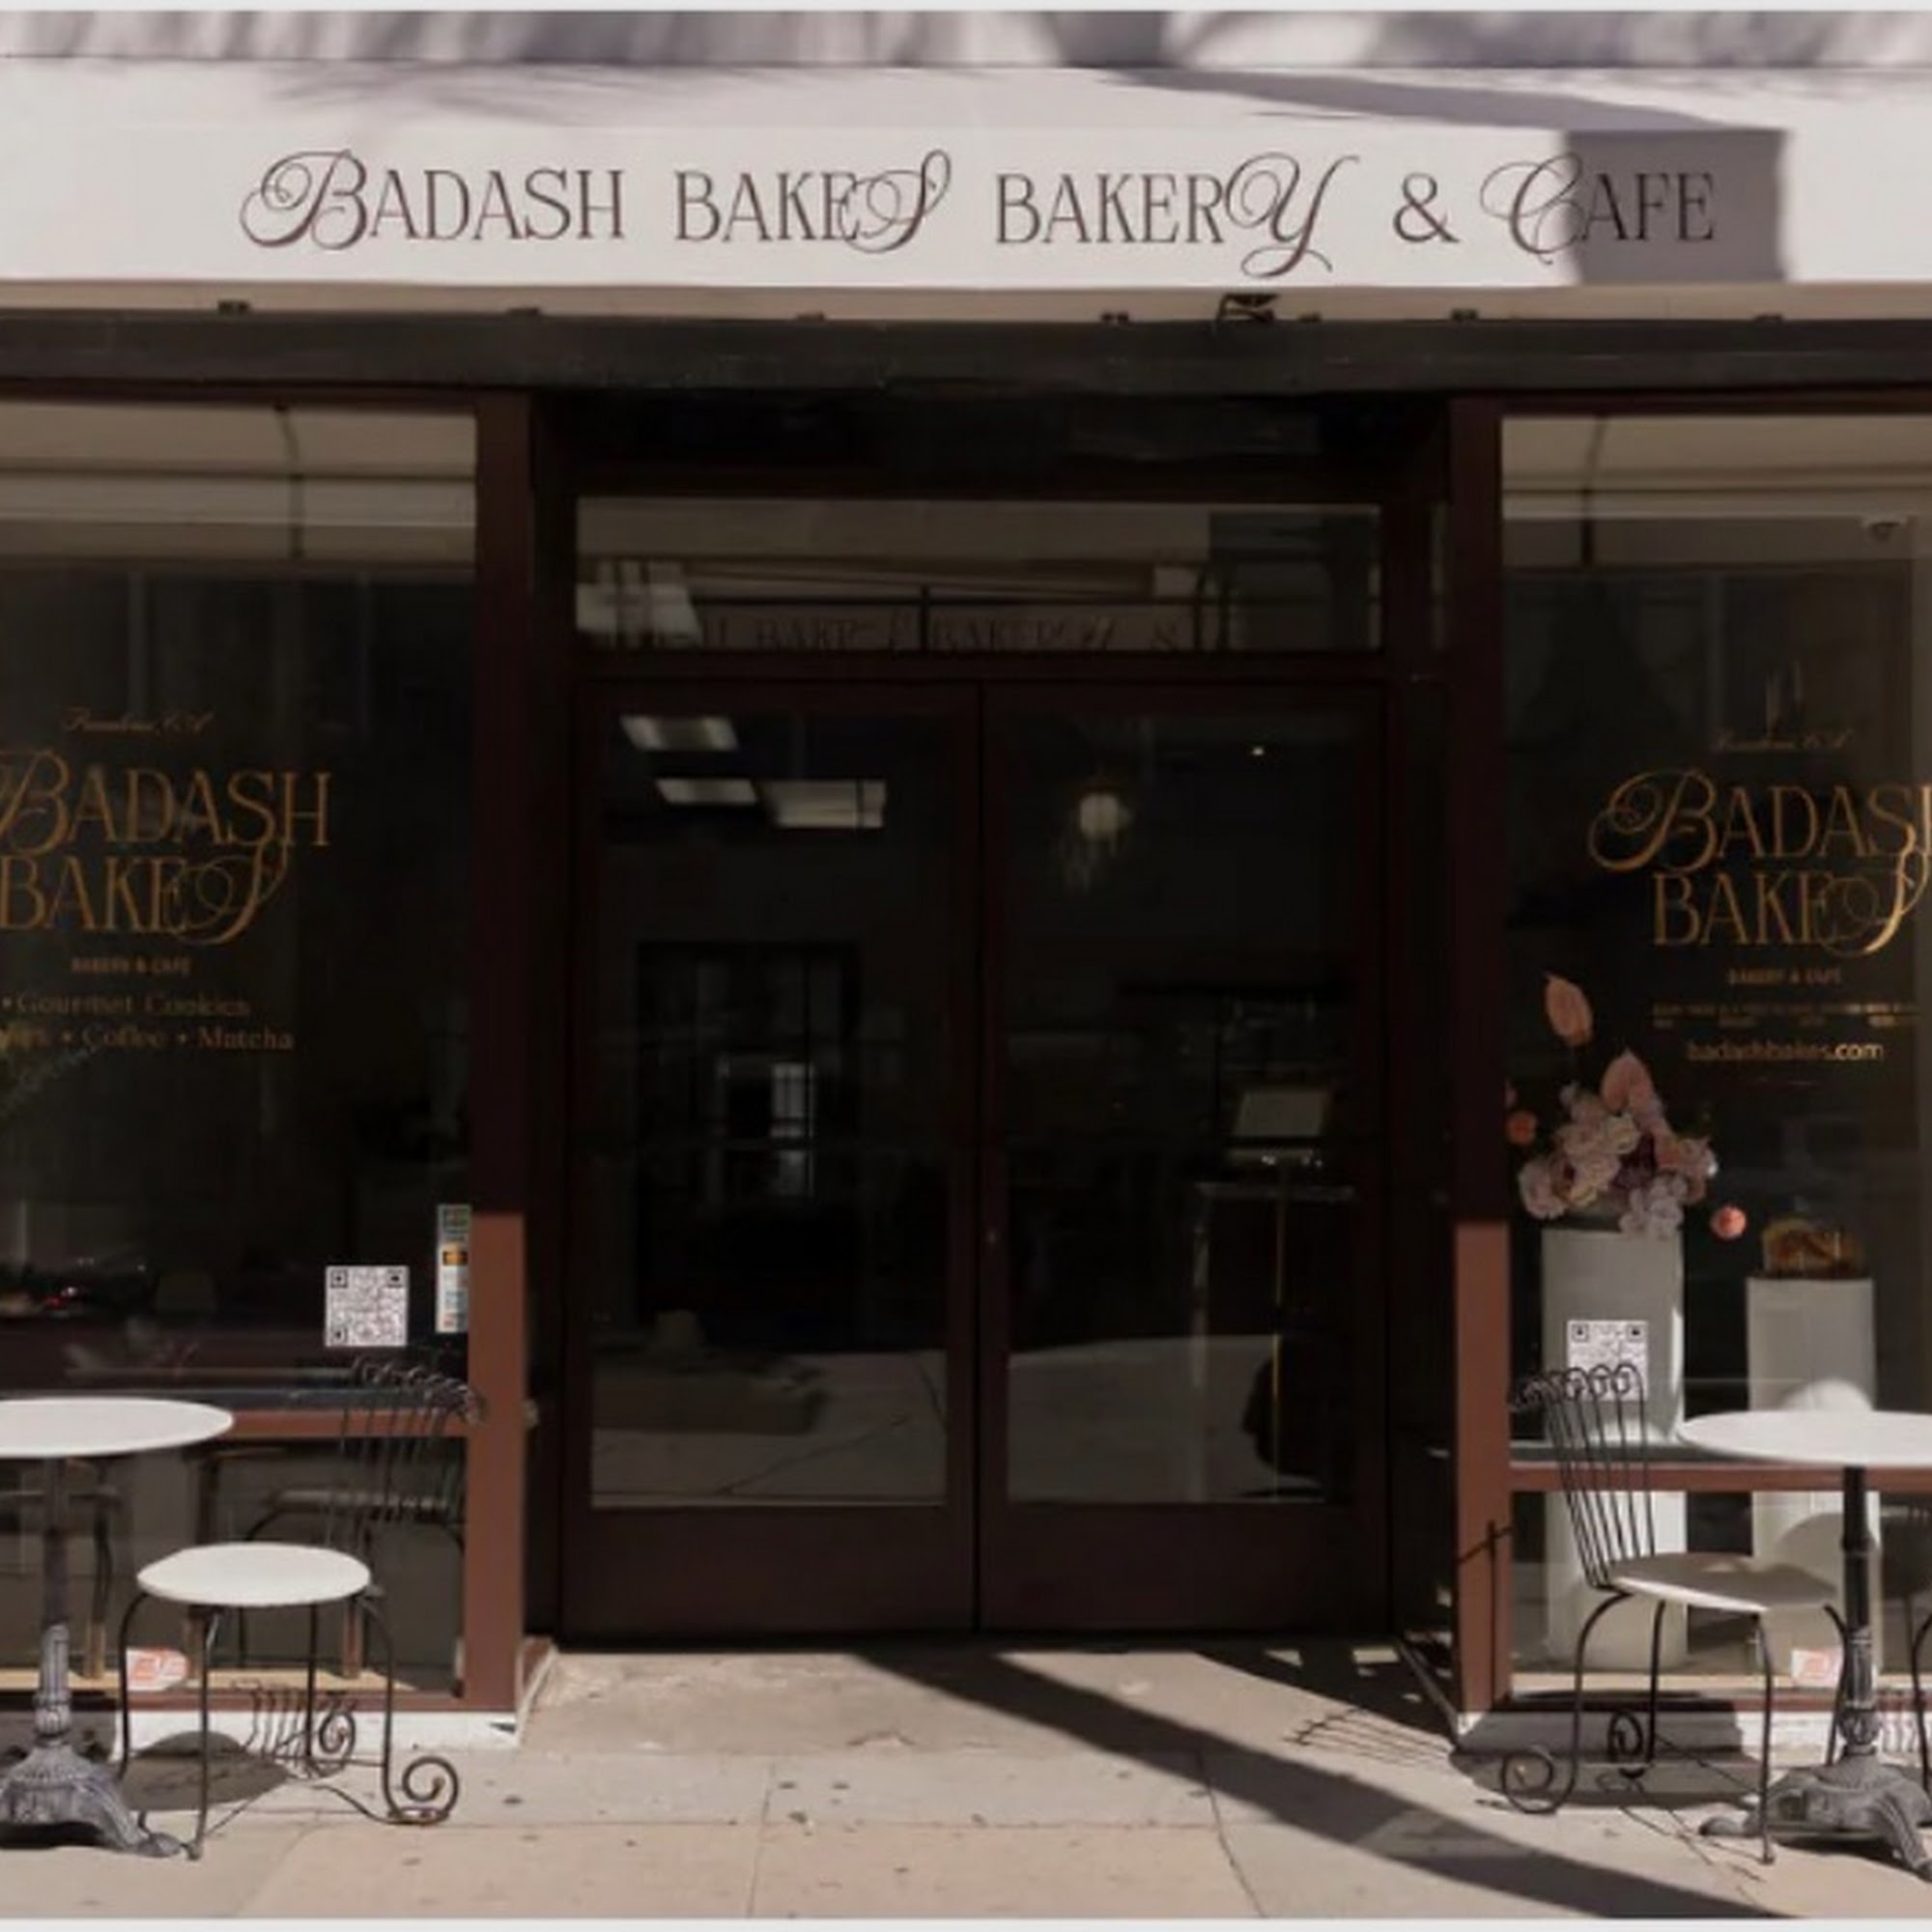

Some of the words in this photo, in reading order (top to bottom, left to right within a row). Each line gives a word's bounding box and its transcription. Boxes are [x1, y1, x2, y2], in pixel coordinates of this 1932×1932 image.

[241, 150, 625, 250] BADASH
[674, 150, 951, 253] BAKES
[995, 152, 1359, 278] BAKERY
[1393, 171, 1460, 243] &
[1480, 152, 1717, 266] CAFE
[0, 749, 331, 855] BADASH
[0, 837, 290, 946] BAKES
[1653, 843, 1929, 957] BAKES
[197, 1025, 295, 1049] Matcha
